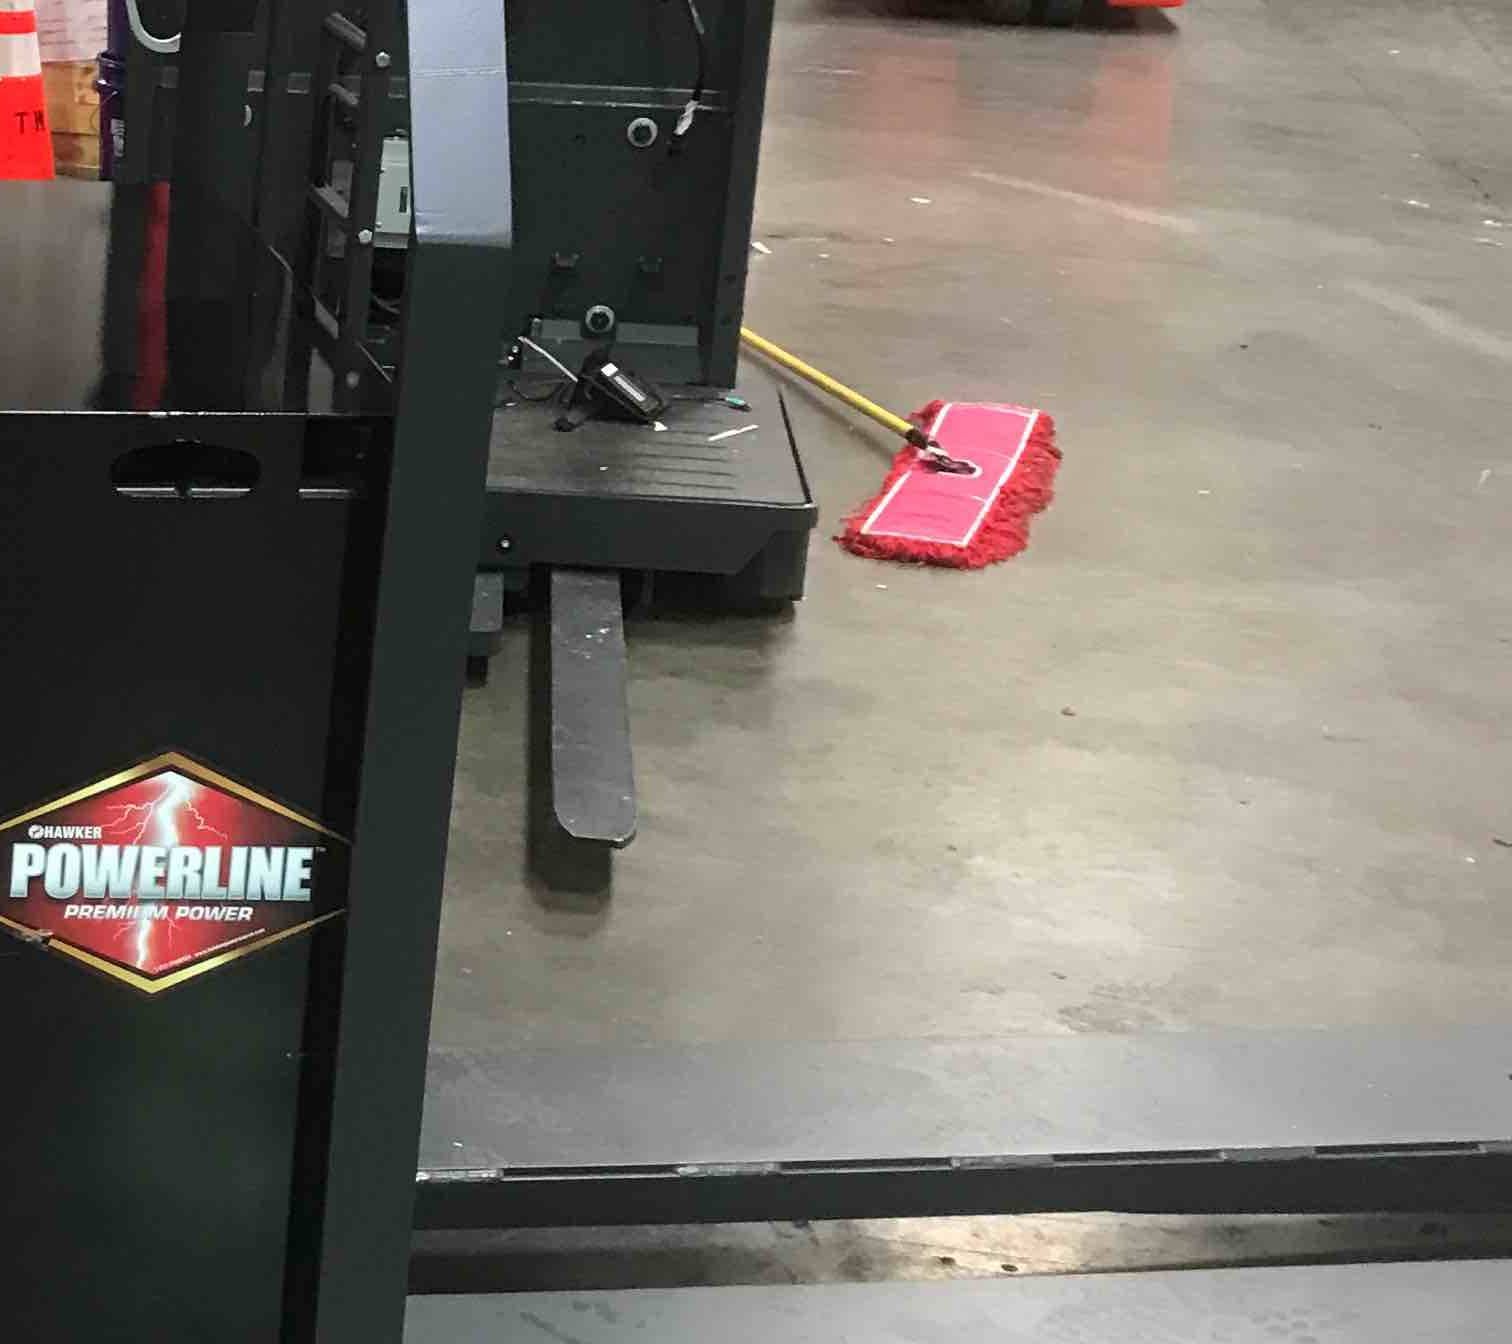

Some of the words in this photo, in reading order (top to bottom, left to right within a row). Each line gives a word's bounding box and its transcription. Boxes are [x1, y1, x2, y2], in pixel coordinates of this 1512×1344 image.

[43, 825, 102, 839] HAWKER
[9, 842, 314, 902] POWERLINE
[174, 905, 254, 922] POWER
